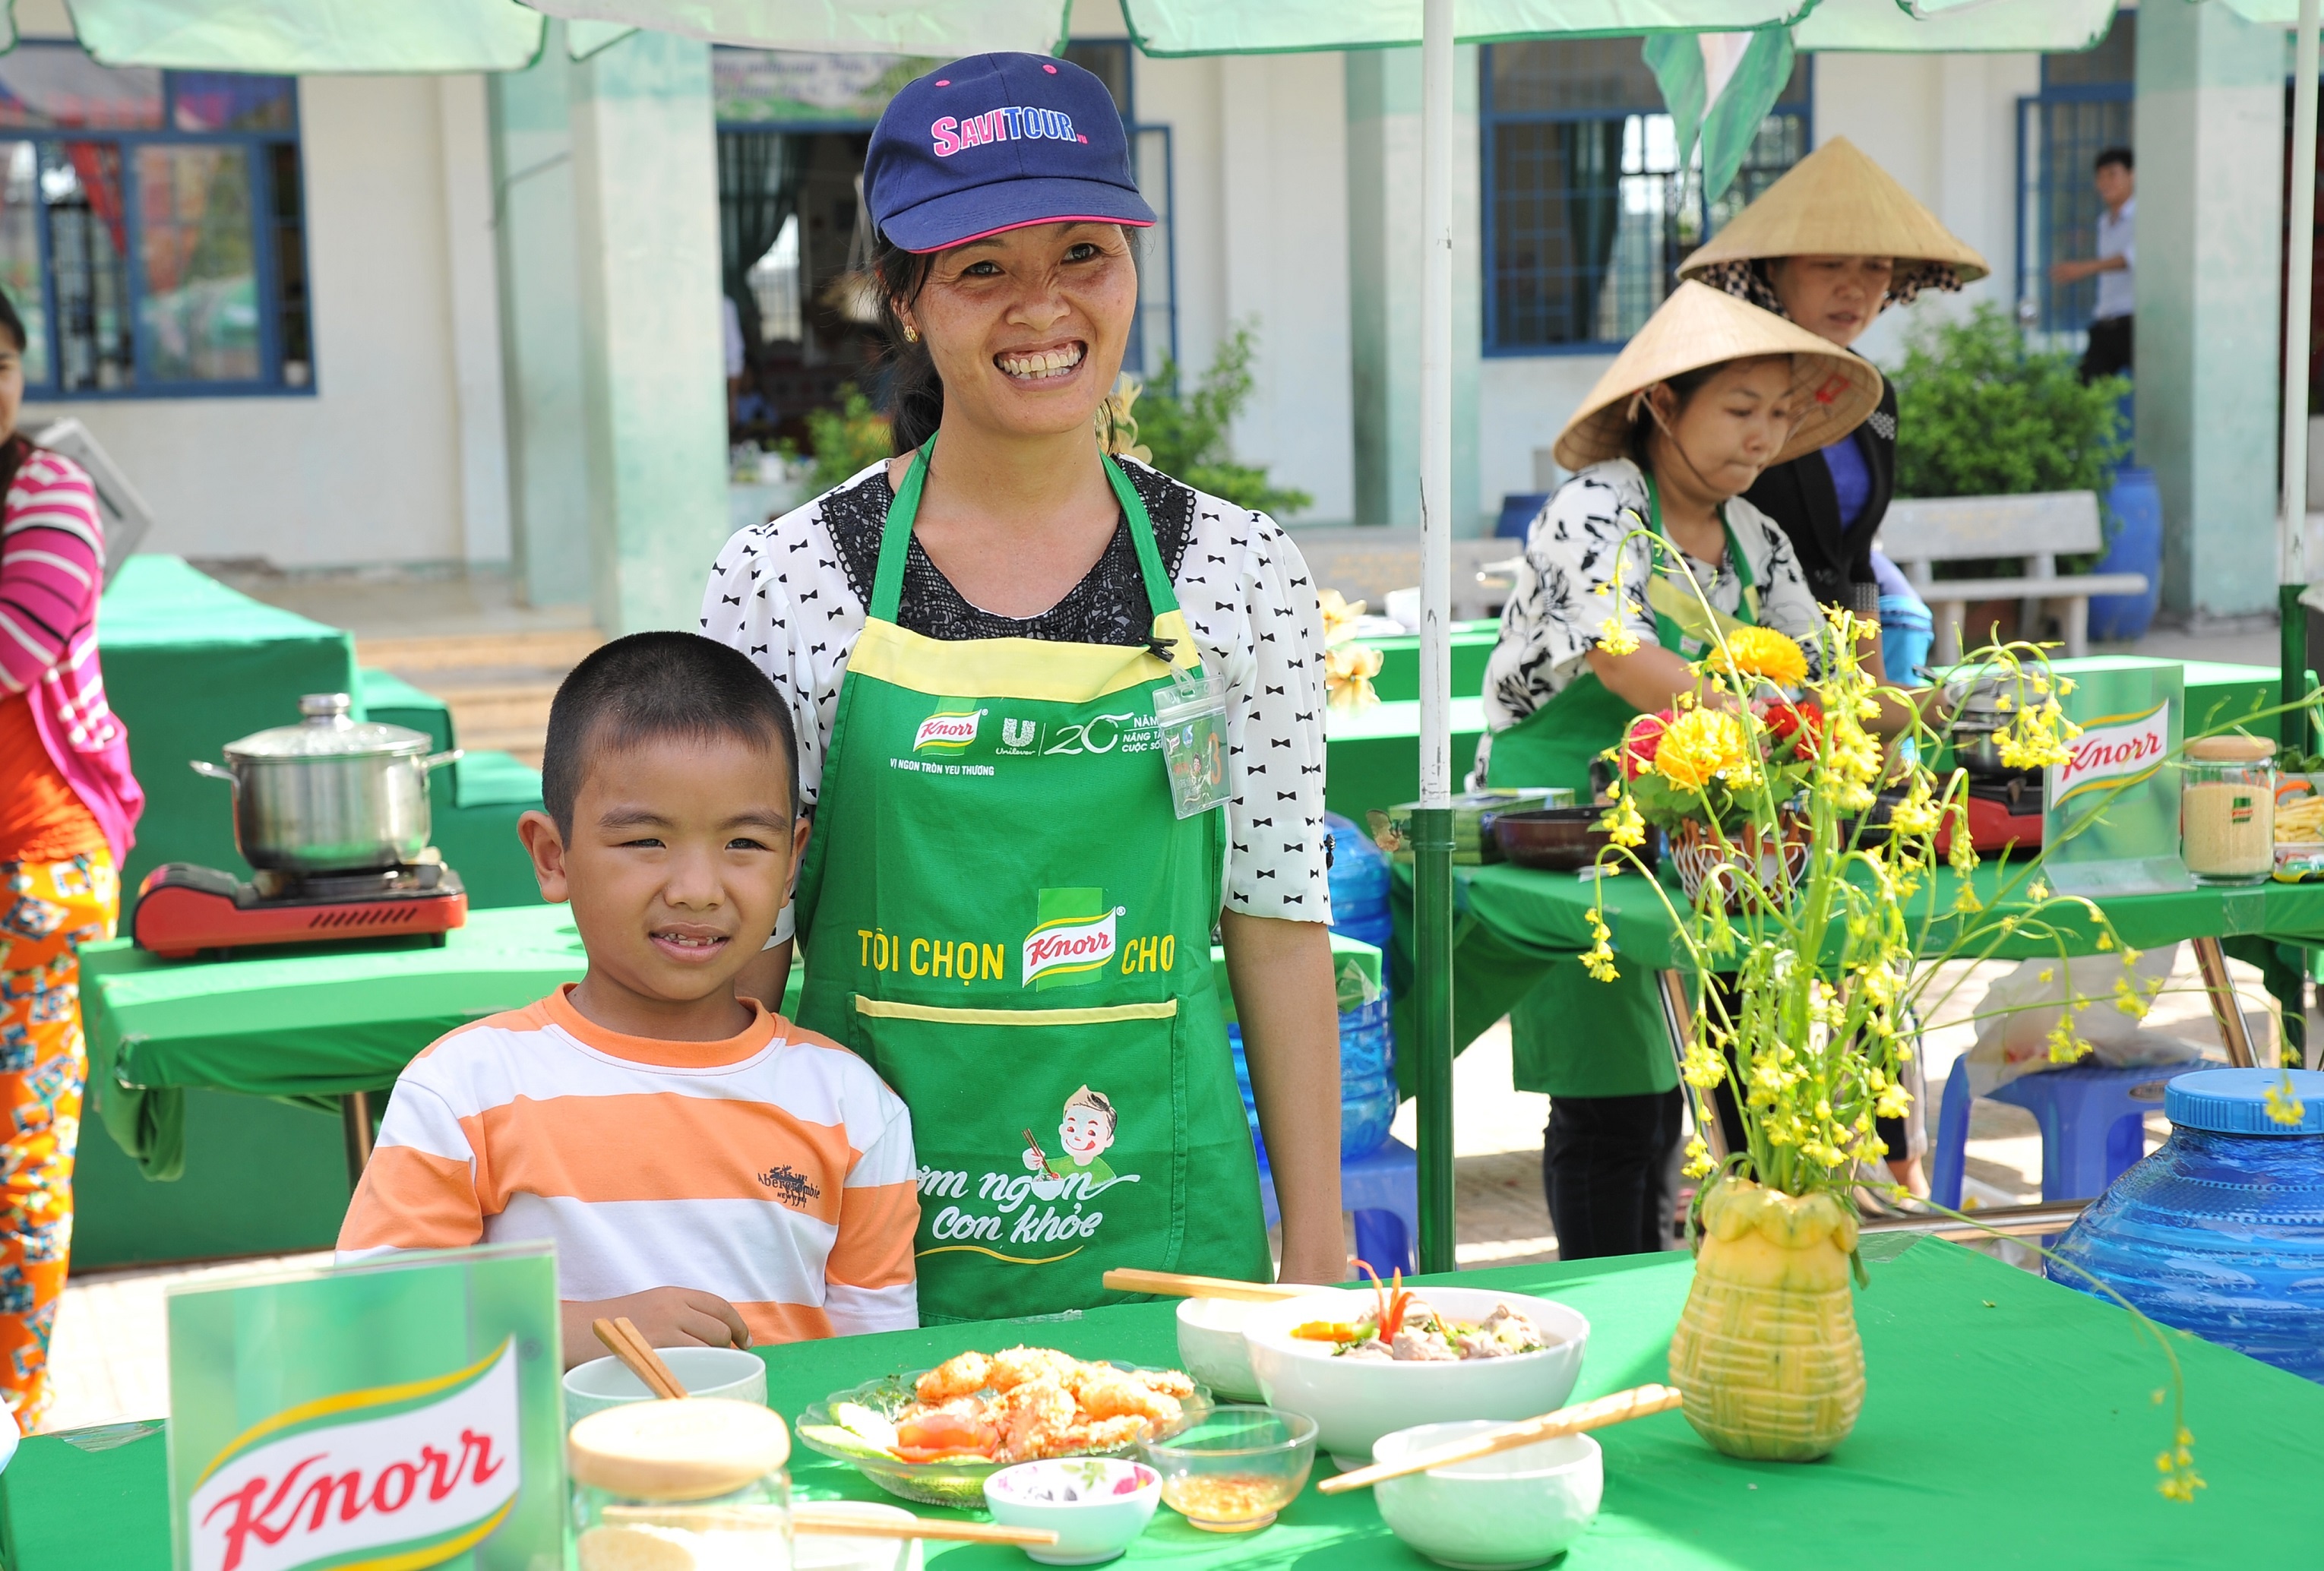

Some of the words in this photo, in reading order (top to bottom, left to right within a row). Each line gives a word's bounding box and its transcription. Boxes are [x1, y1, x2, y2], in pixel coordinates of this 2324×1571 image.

[920, 720, 975, 738] Knorr
[898, 759, 920, 773] NGON
[921, 762, 943, 774] TRÒN
[995, 747, 1036, 755] Unilever
[2062, 732, 2162, 782] Knorr
[909, 937, 1004, 986] CHỌN
[1026, 931, 1111, 967] Knorr
[1121, 934, 1175, 975] CHO
[916, 1165, 969, 1199] ơm
[932, 1206, 1004, 1241] Con
[201, 1427, 505, 1571] Knorr
